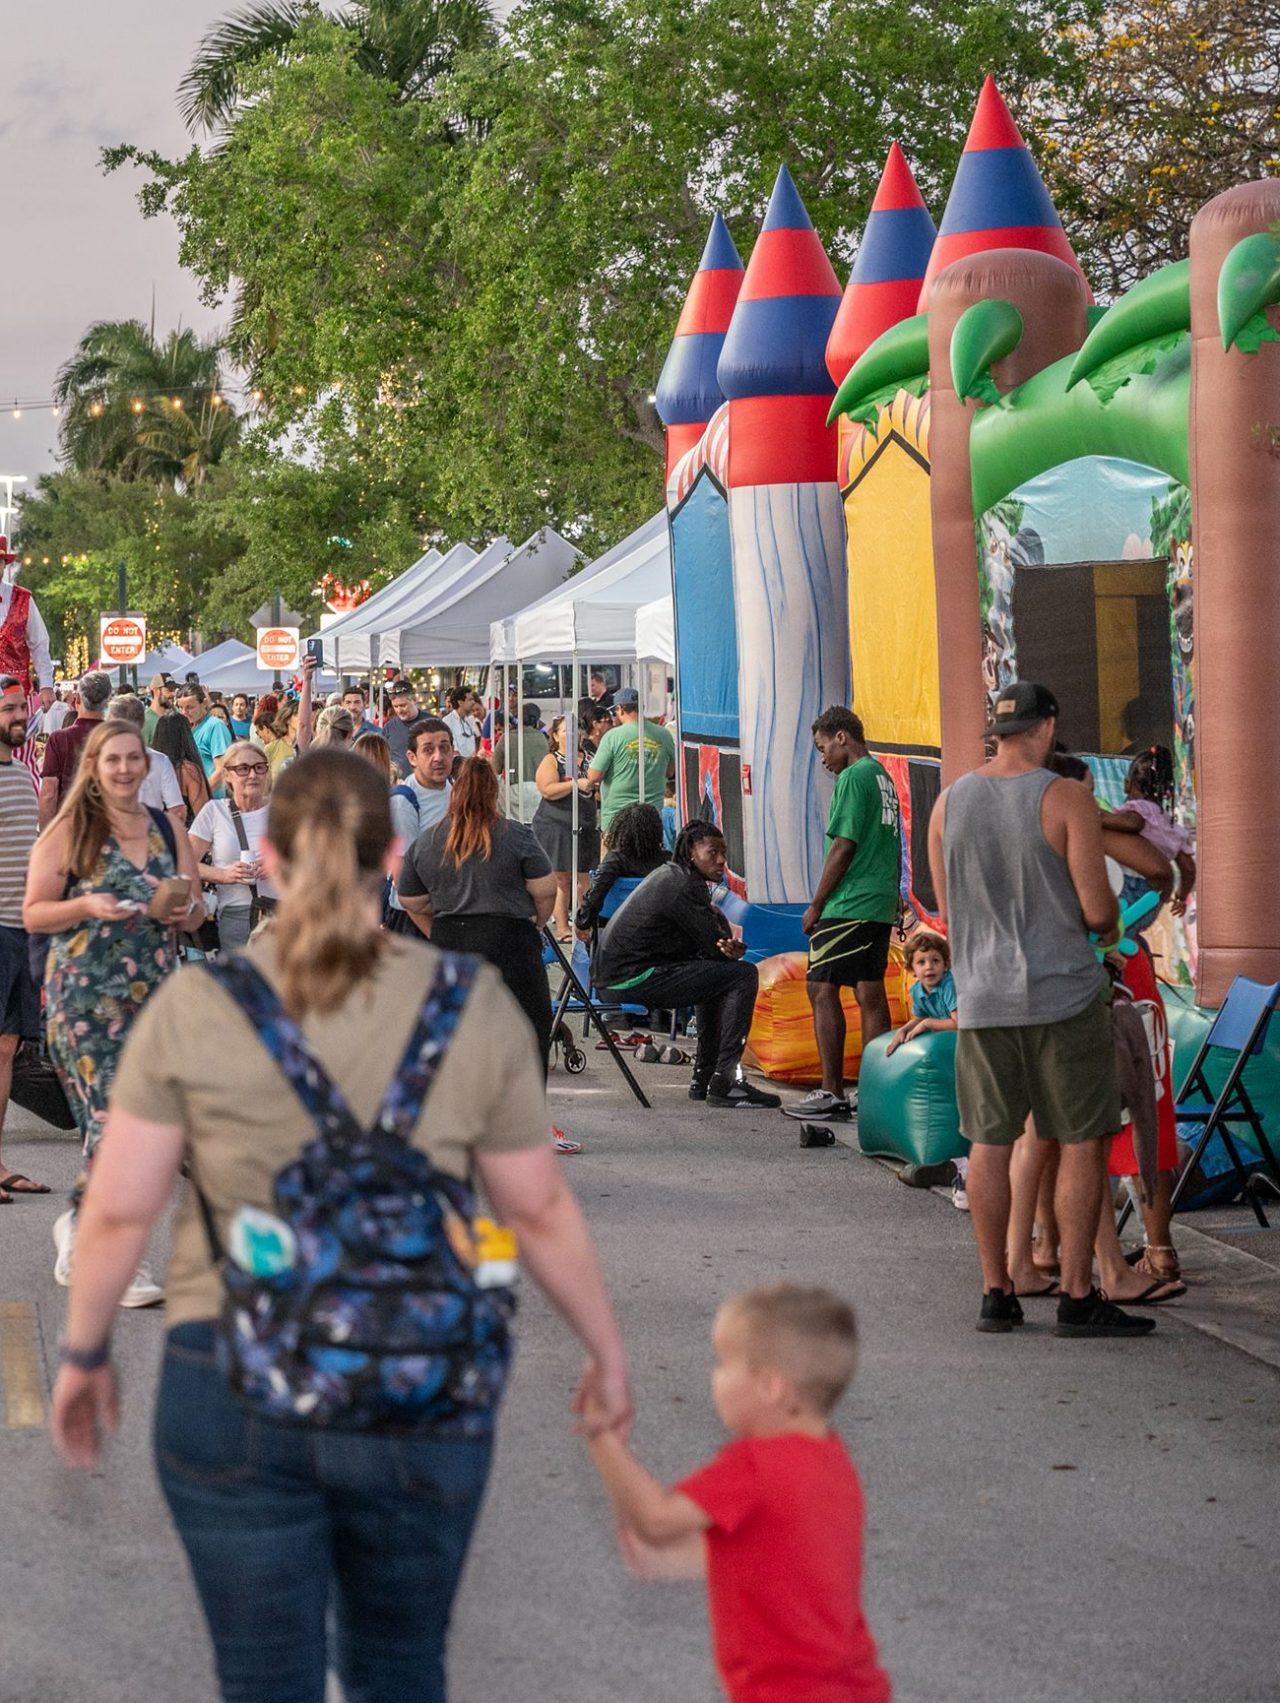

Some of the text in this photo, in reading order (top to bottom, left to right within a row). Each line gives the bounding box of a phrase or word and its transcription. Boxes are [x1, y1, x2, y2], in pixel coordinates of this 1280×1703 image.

[108, 627, 138, 635] DO NOT
[263, 636, 274, 644] DO
[111, 646, 136, 655] ENTER
